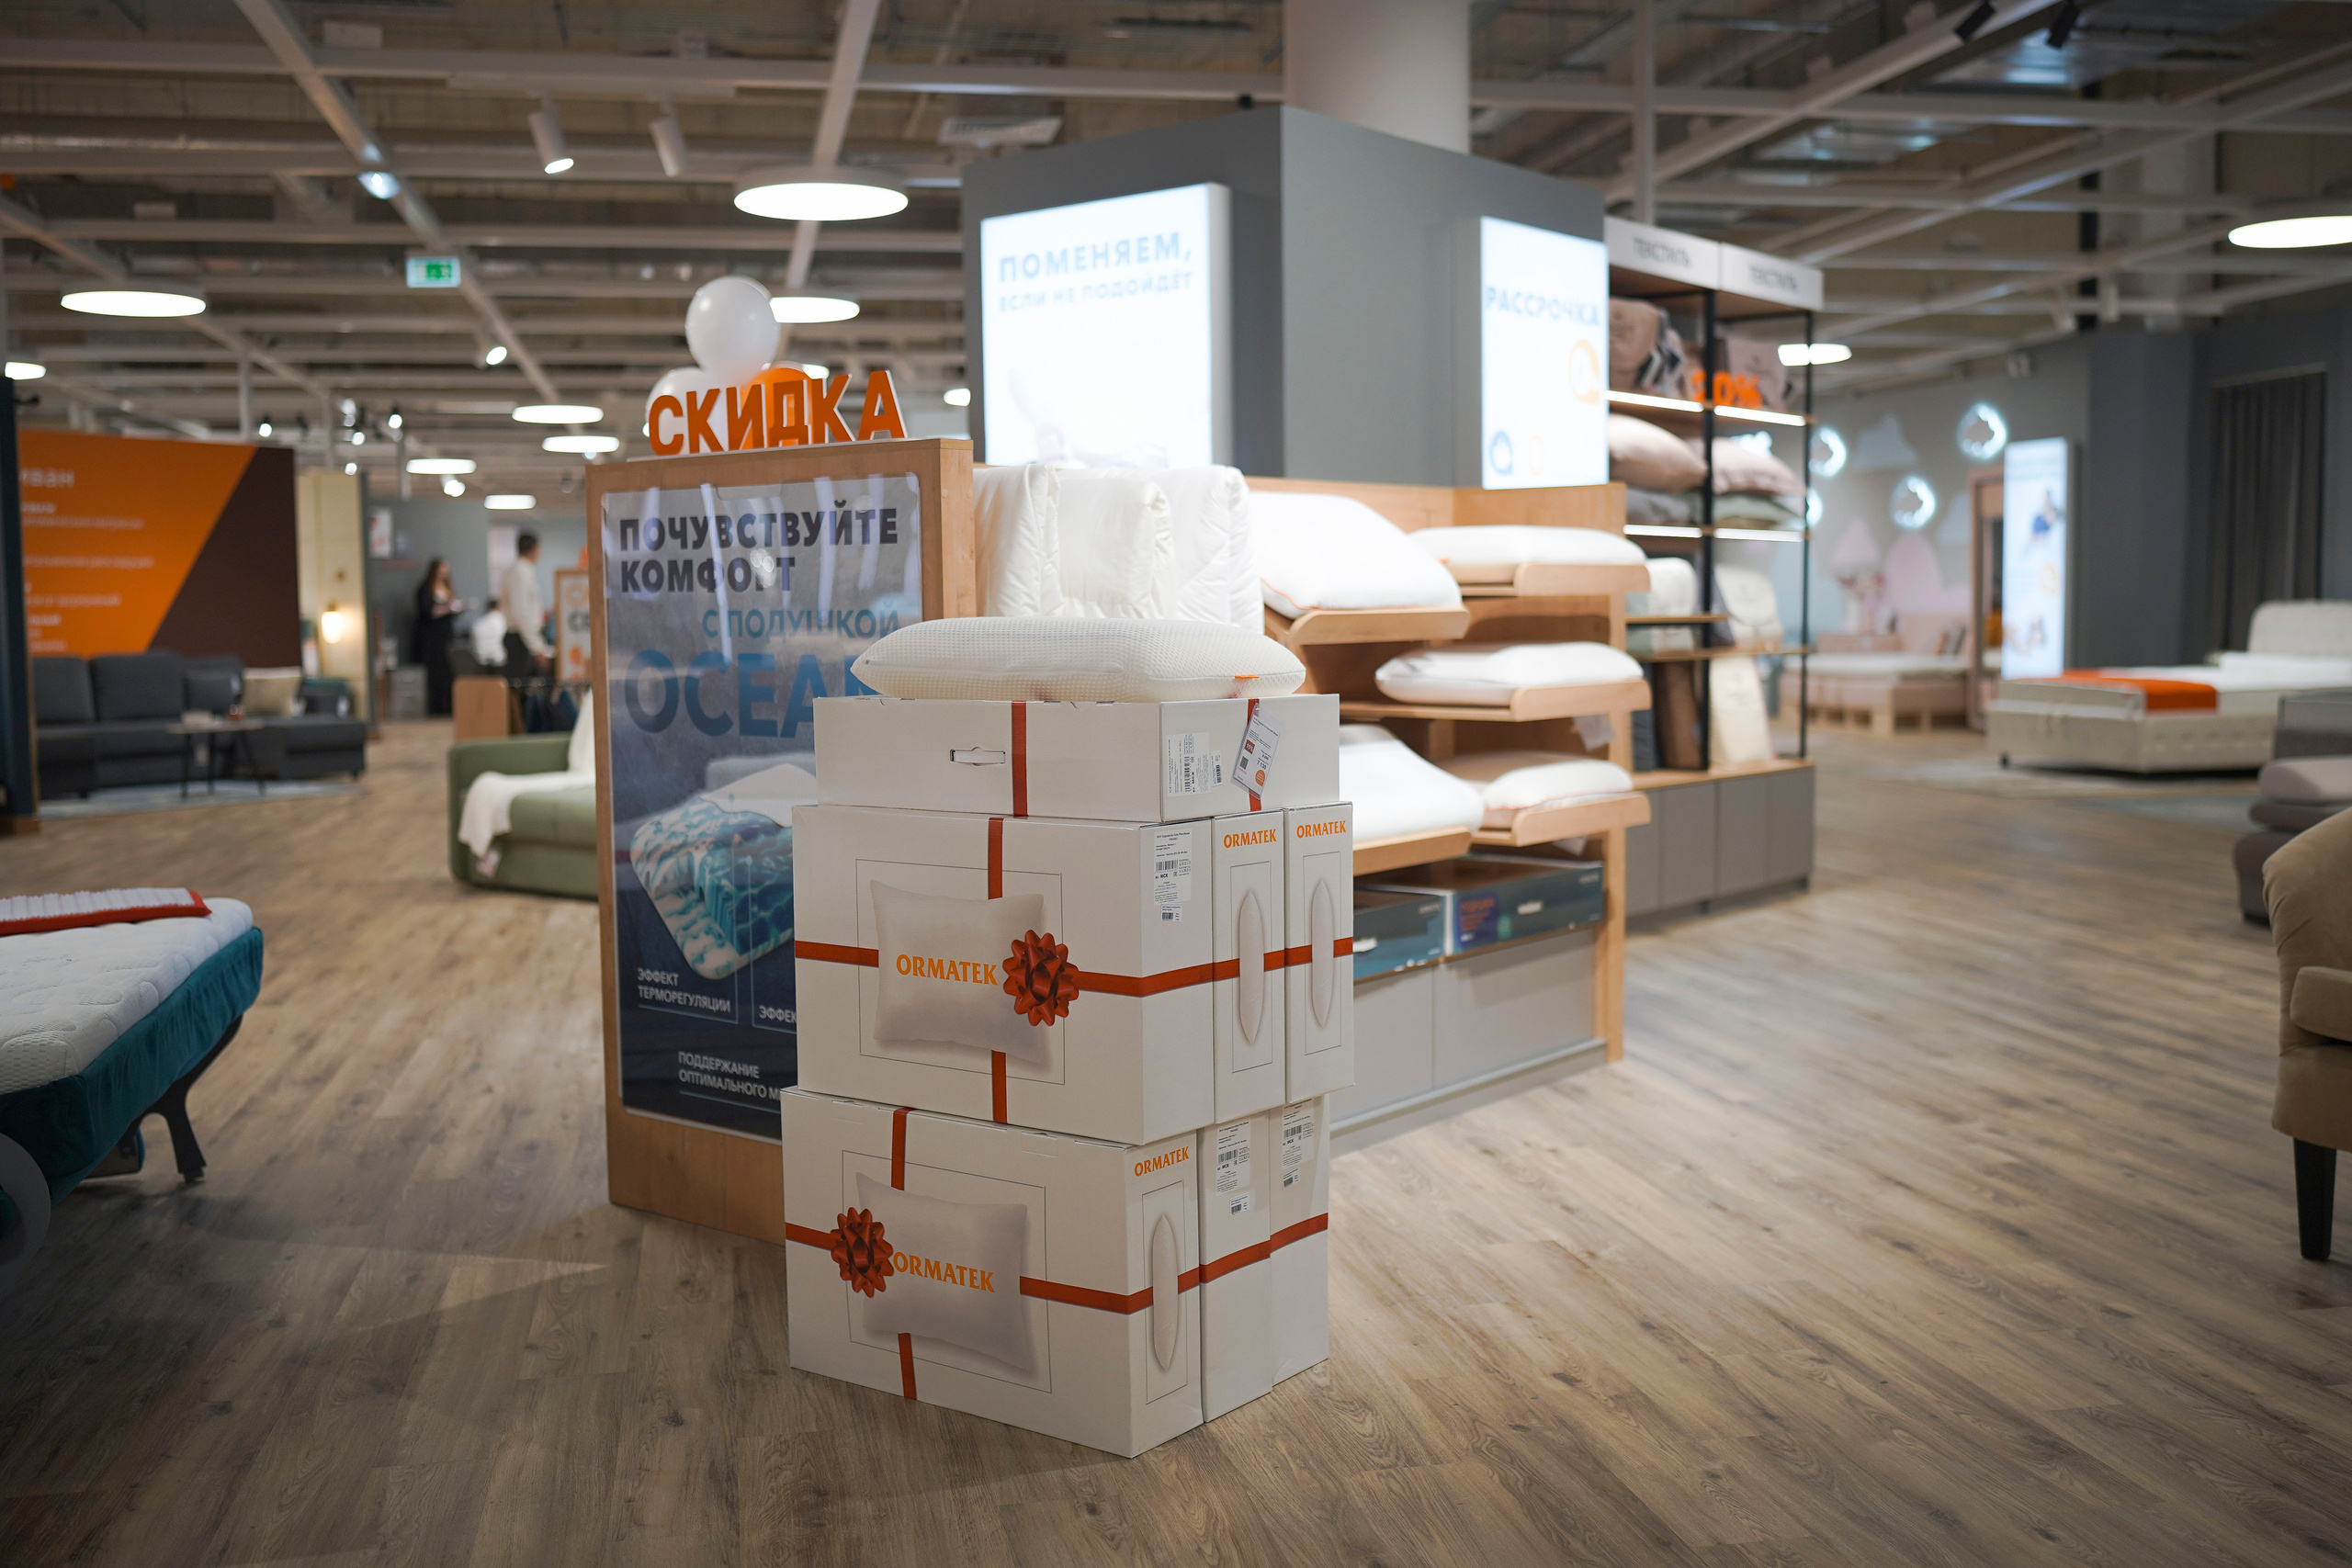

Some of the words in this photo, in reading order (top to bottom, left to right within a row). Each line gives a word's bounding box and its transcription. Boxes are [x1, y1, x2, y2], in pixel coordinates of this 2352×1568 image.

[999, 231, 1192, 283] ПОМЕНЯЕМ,
[1053, 287, 1075, 304] НЕ
[1485, 286, 1600, 326] РАССРОЧКА
[649, 370, 908, 457] СКИДКА
[619, 500, 899, 552] ПОЧУВСТВУЙТЕ
[1223, 829, 1276, 848] ORMATEK
[1296, 820, 1345, 838] ORMATEK
[637, 967, 679, 987] ЭФФЕКТ
[896, 953, 997, 985] ORMATEK
[638, 986, 730, 1013] ТЕРМОРЕГУЛЯЦИИ
[678, 1051, 760, 1079] ПОДДЕРЖАНИЕ
[678, 1070, 767, 1100] ОПТИМАЛЬНОГО
[1134, 1146, 1189, 1176] ORMATEK
[892, 1251, 994, 1292] ORMATEK
